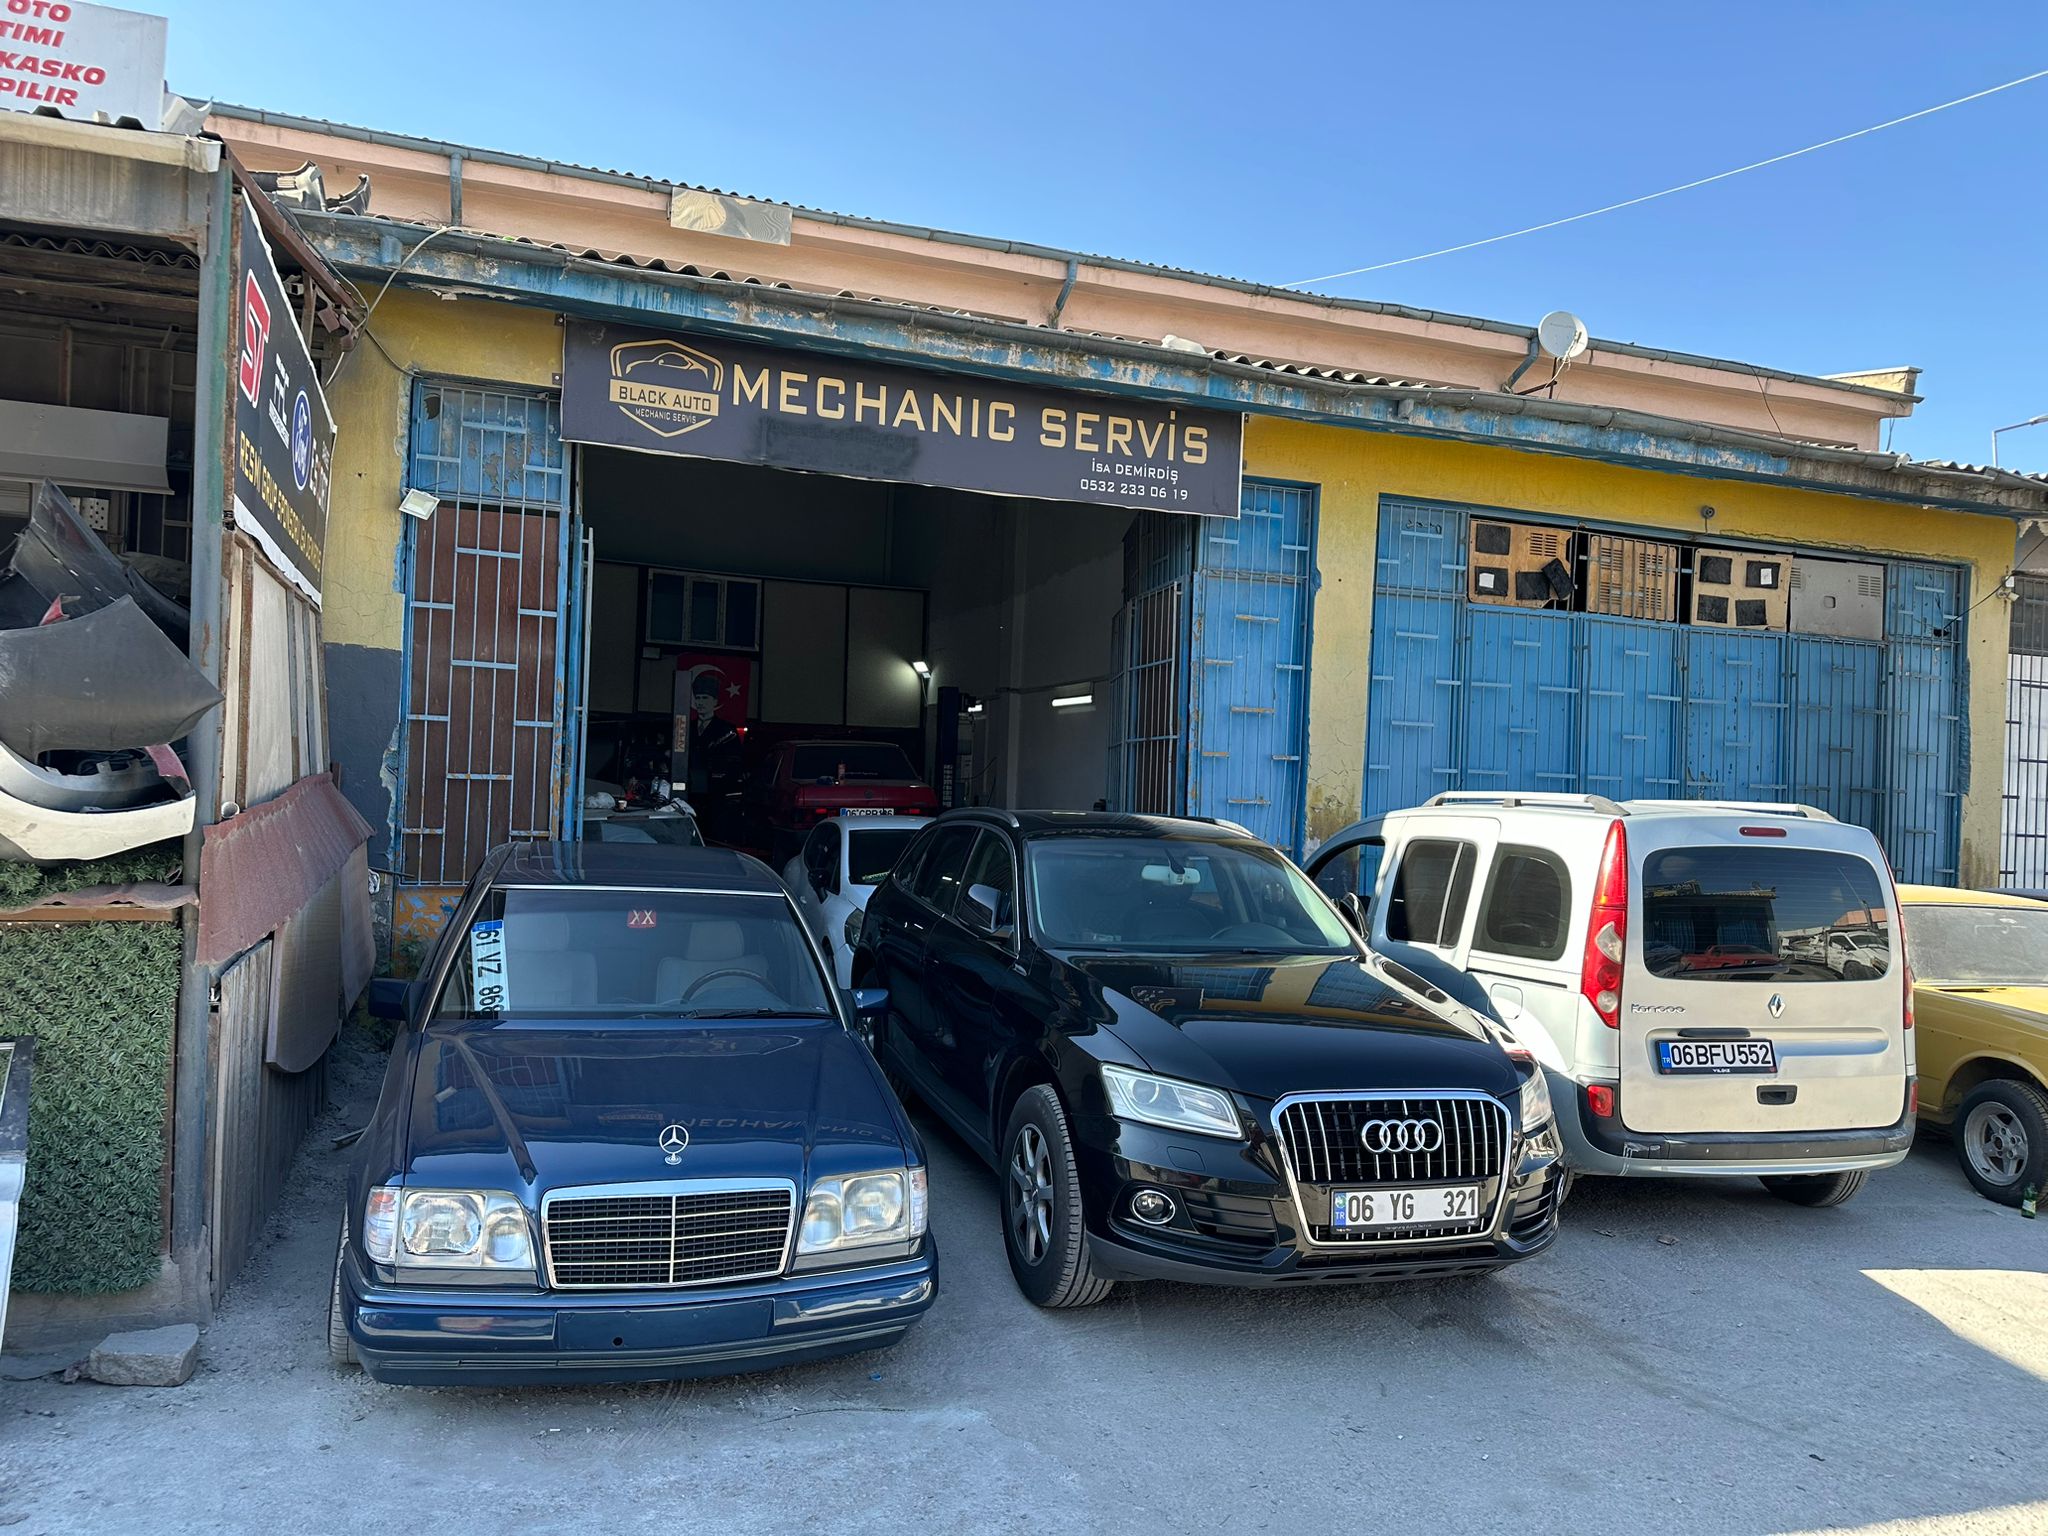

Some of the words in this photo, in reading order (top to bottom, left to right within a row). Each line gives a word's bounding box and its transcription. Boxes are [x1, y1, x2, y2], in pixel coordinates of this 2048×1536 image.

[8, 0, 71, 22] OTO
[0, 50, 106, 85] KASKO
[619, 386, 667, 405] BLACK
[673, 394, 711, 412] AUTO
[635, 408, 671, 420] MECHANIC
[733, 364, 1015, 442] MECHANIC
[1040, 408, 1208, 464] SERVİS
[1115, 463, 1179, 485] DEMİRDİŞ
[1080, 478, 1115, 493] 0532
[1120, 483, 1145, 496] 233
[1150, 486, 1167, 498] 06
[1173, 489, 1188, 500] 19
[476, 930, 500, 946] 61
[477, 951, 502, 977] VZ
[1335, 1211, 1345, 1220] TR
[1348, 1194, 1374, 1222] 06
[1390, 1193, 1414, 1220] YG
[1443, 1190, 1476, 1217] 321
